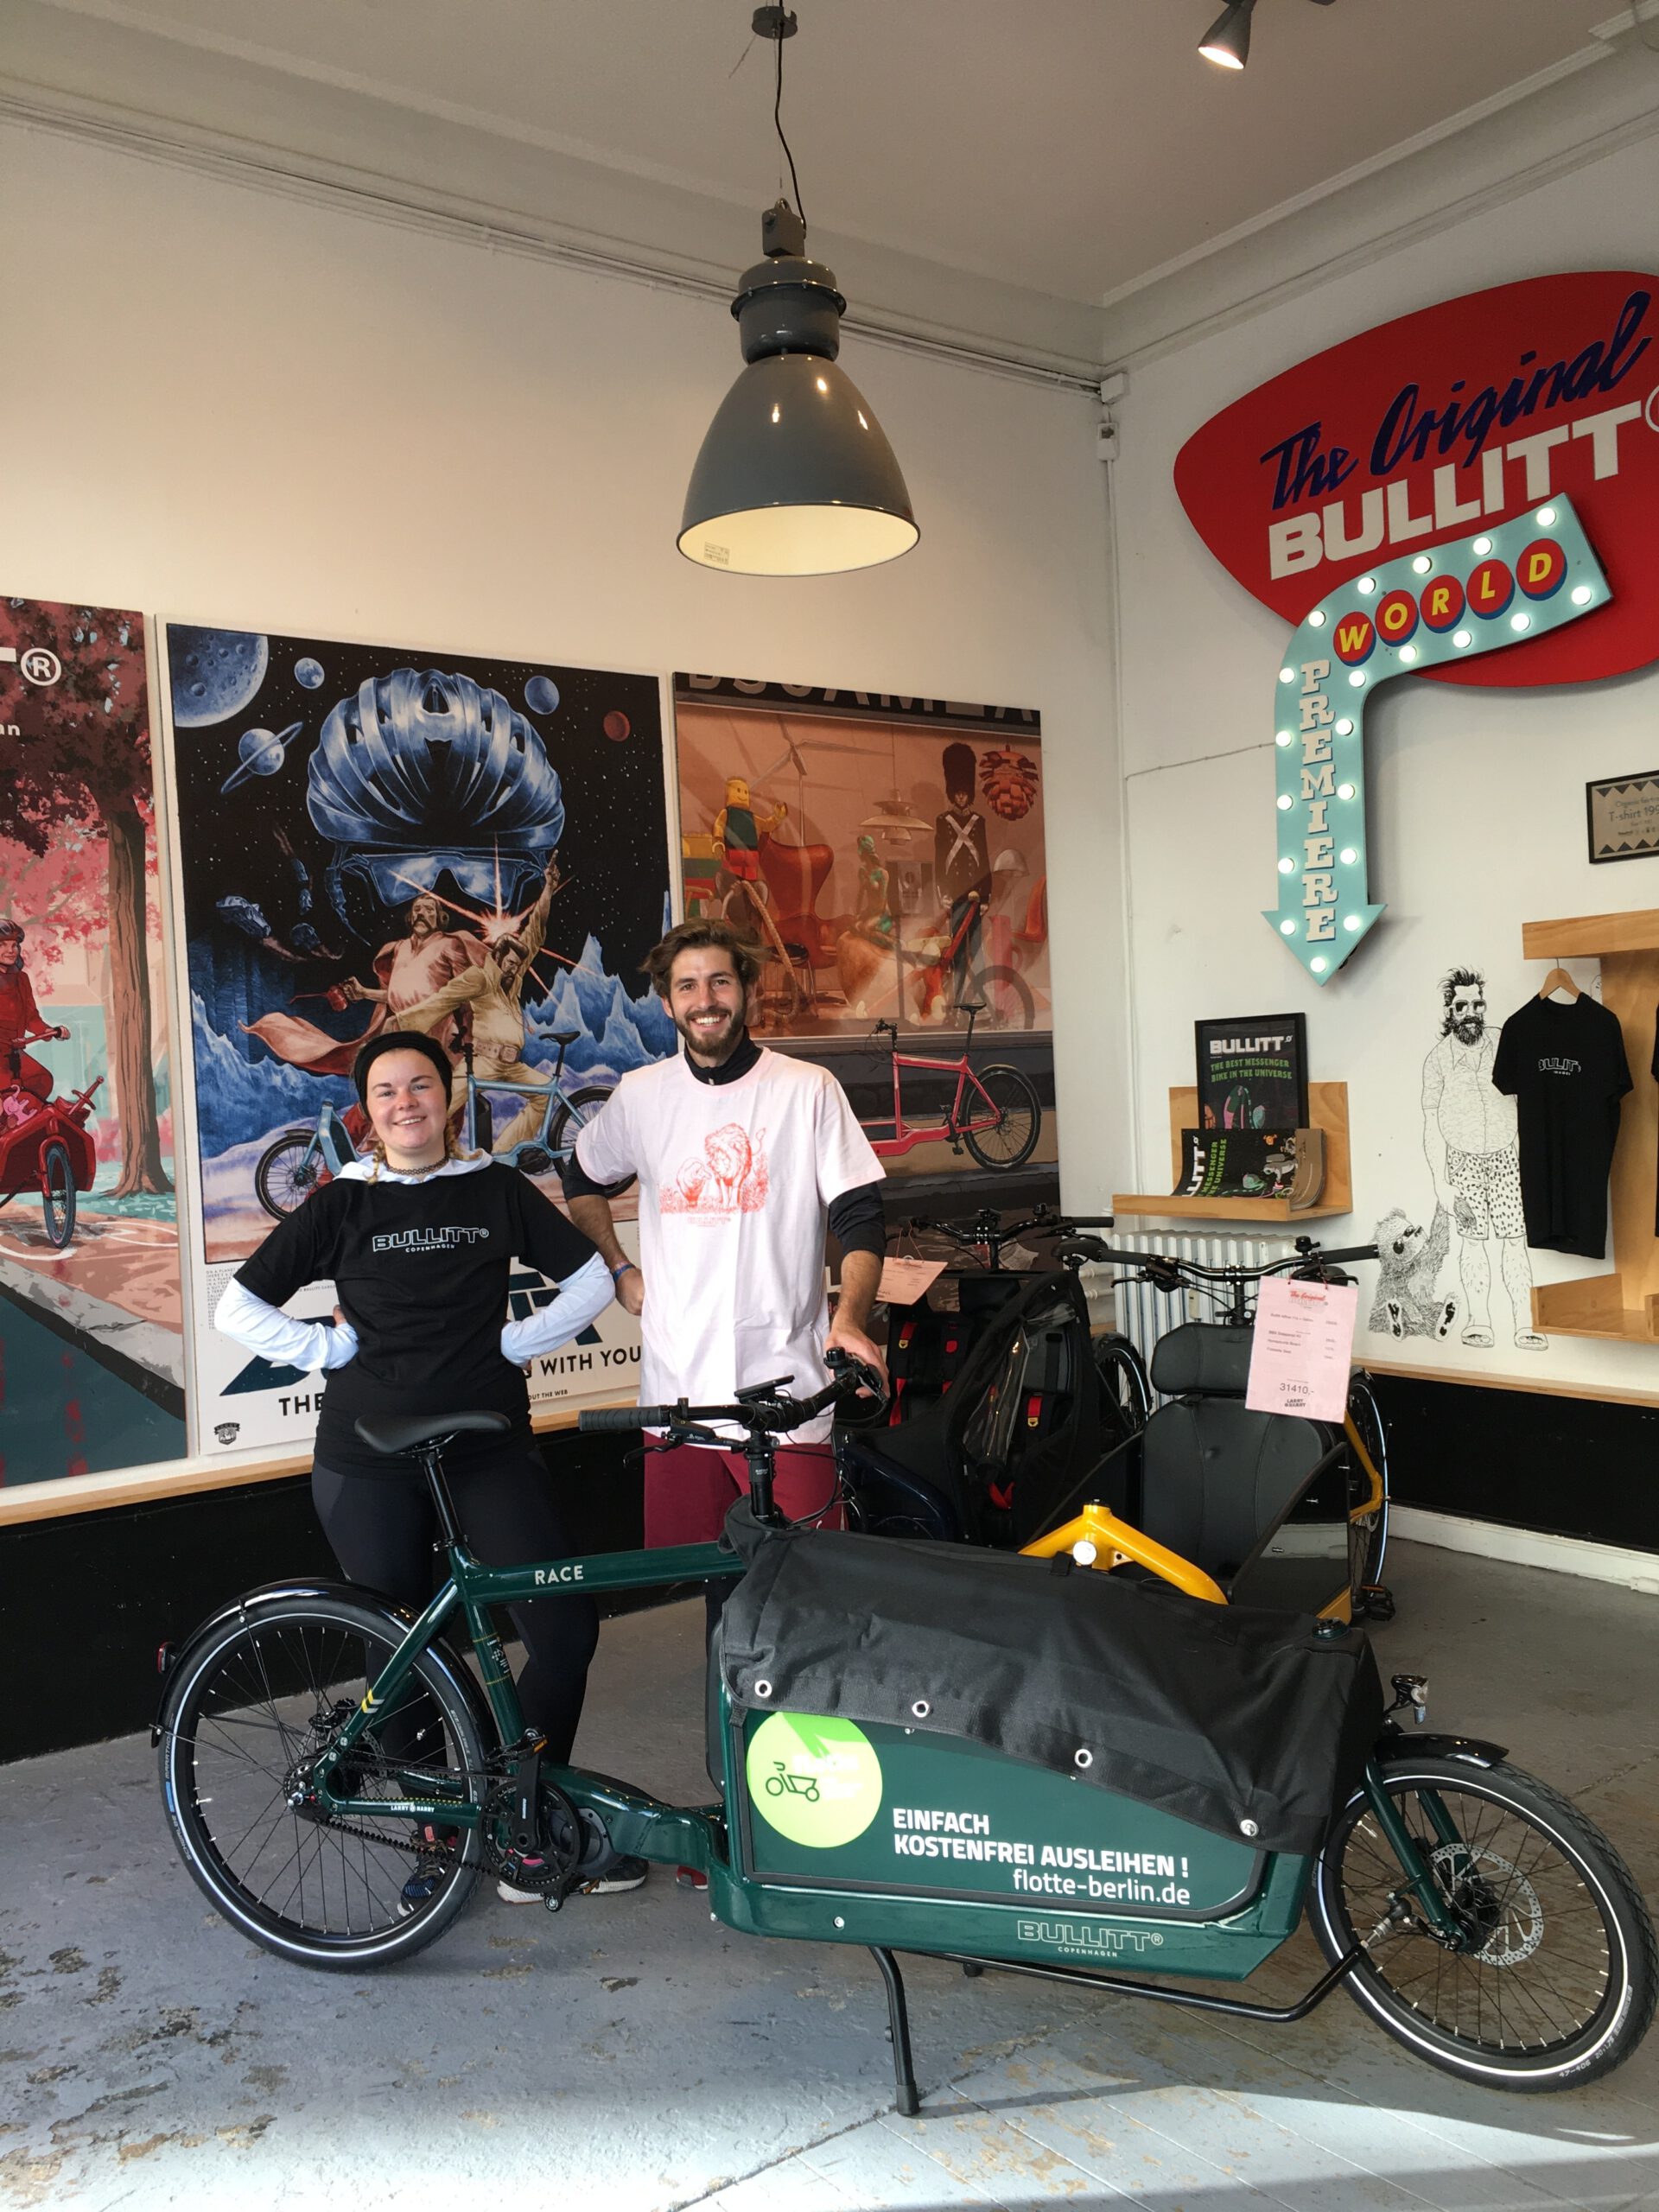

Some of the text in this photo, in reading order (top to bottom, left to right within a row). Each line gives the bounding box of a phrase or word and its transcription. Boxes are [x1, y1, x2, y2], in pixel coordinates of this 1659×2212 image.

[1260, 290, 1653, 511] The Original
[1338, 550, 1554, 654] WORLD
[1299, 659, 1338, 942] PREMIERE
[1211, 1058, 1289, 1071] THE BEST MESSENGER
[1211, 1073, 1228, 1083] BIKE
[1255, 1069, 1292, 1079] UNIVERSE
[405, 1244, 455, 1253] COPENHAGEN
[540, 1353, 593, 1376] WITH
[535, 1565, 584, 1586] RACE
[893, 1808, 989, 1835] EINFACH
[894, 1834, 1034, 1866] KOSTENFREI
[1040, 1846, 1175, 1877] AUSLEIHEN
[1013, 1868, 1191, 1905] flotte-berlin.de
[1058, 1946, 1117, 1957] COPENHAGEN
